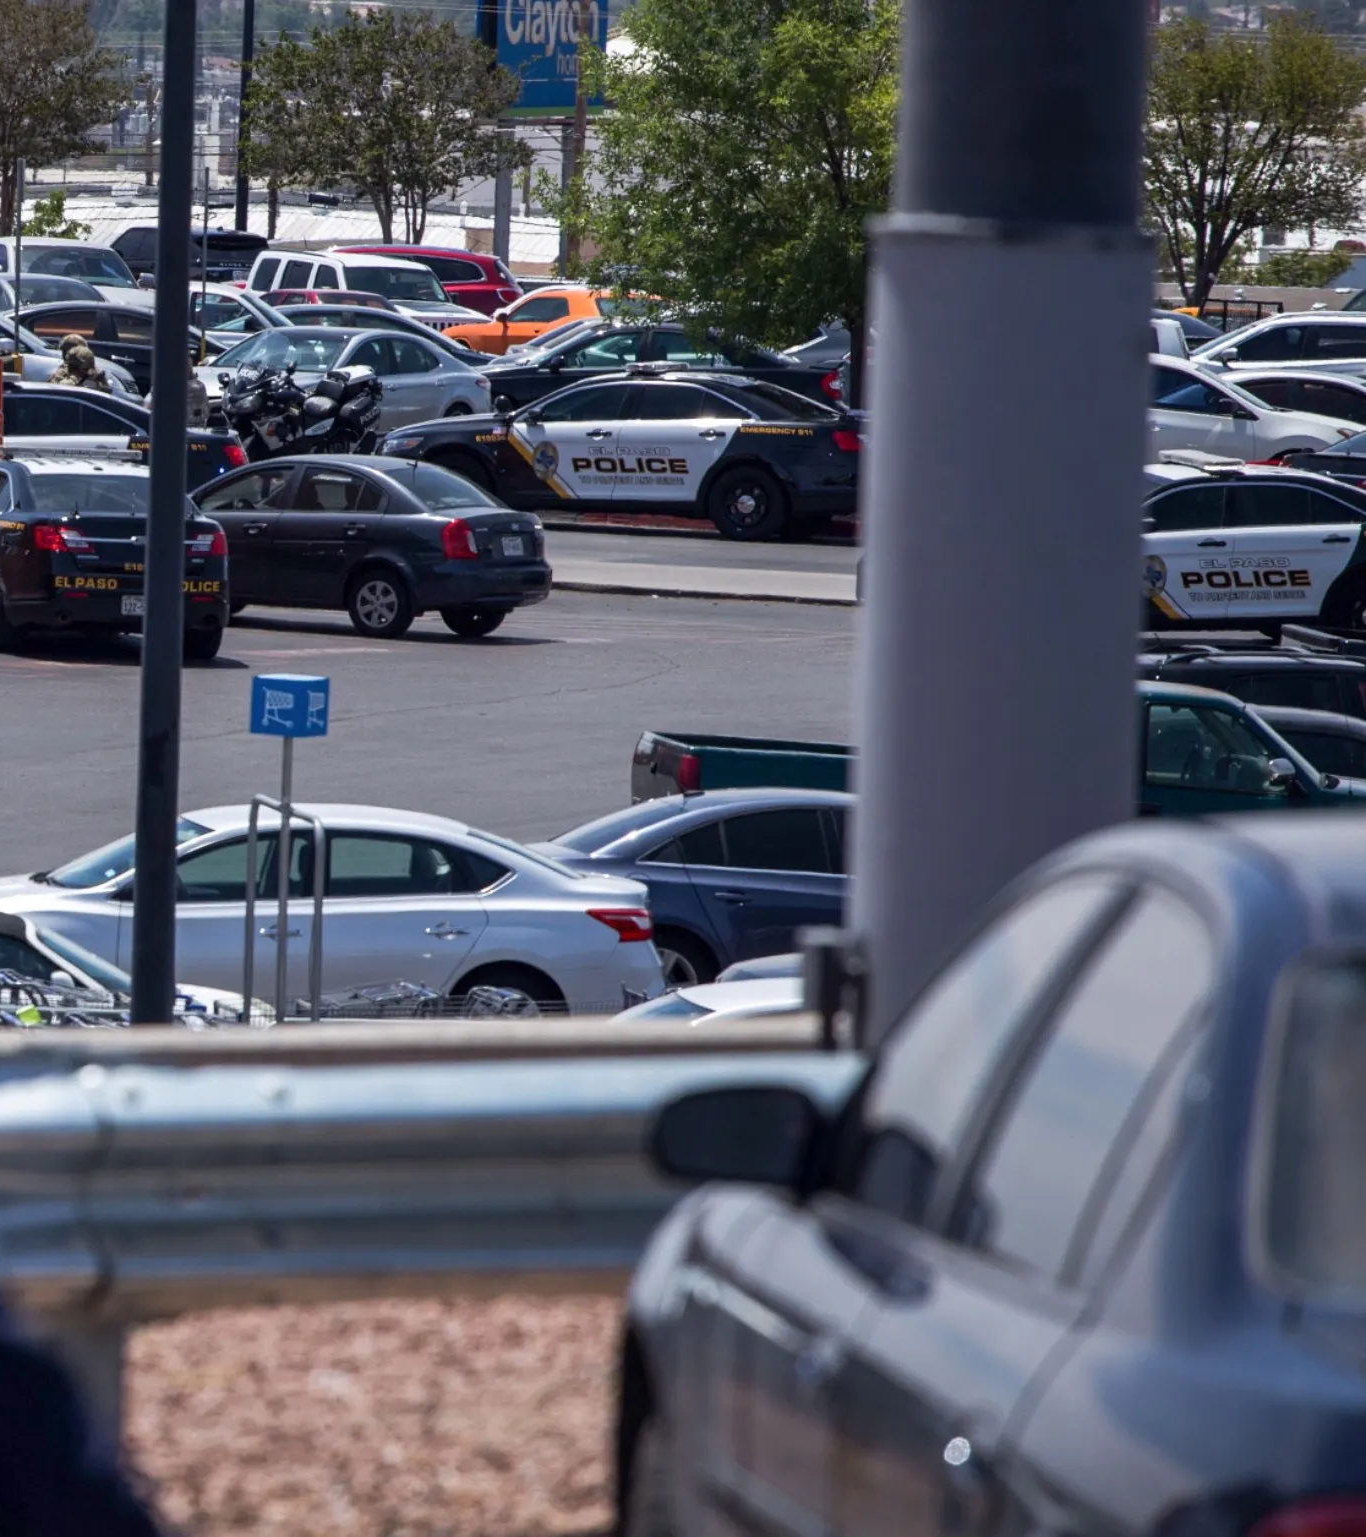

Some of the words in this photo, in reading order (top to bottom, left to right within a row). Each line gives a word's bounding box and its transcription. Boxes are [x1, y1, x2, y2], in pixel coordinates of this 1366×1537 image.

[572, 458, 689, 474] POLICE
[1199, 558, 1227, 568] EL
[1229, 557, 1291, 568] PASO
[54, 576, 71, 588] EL
[75, 578, 118, 590] PASO
[182, 581, 221, 592] OLICE
[1180, 570, 1311, 588] POLICE
